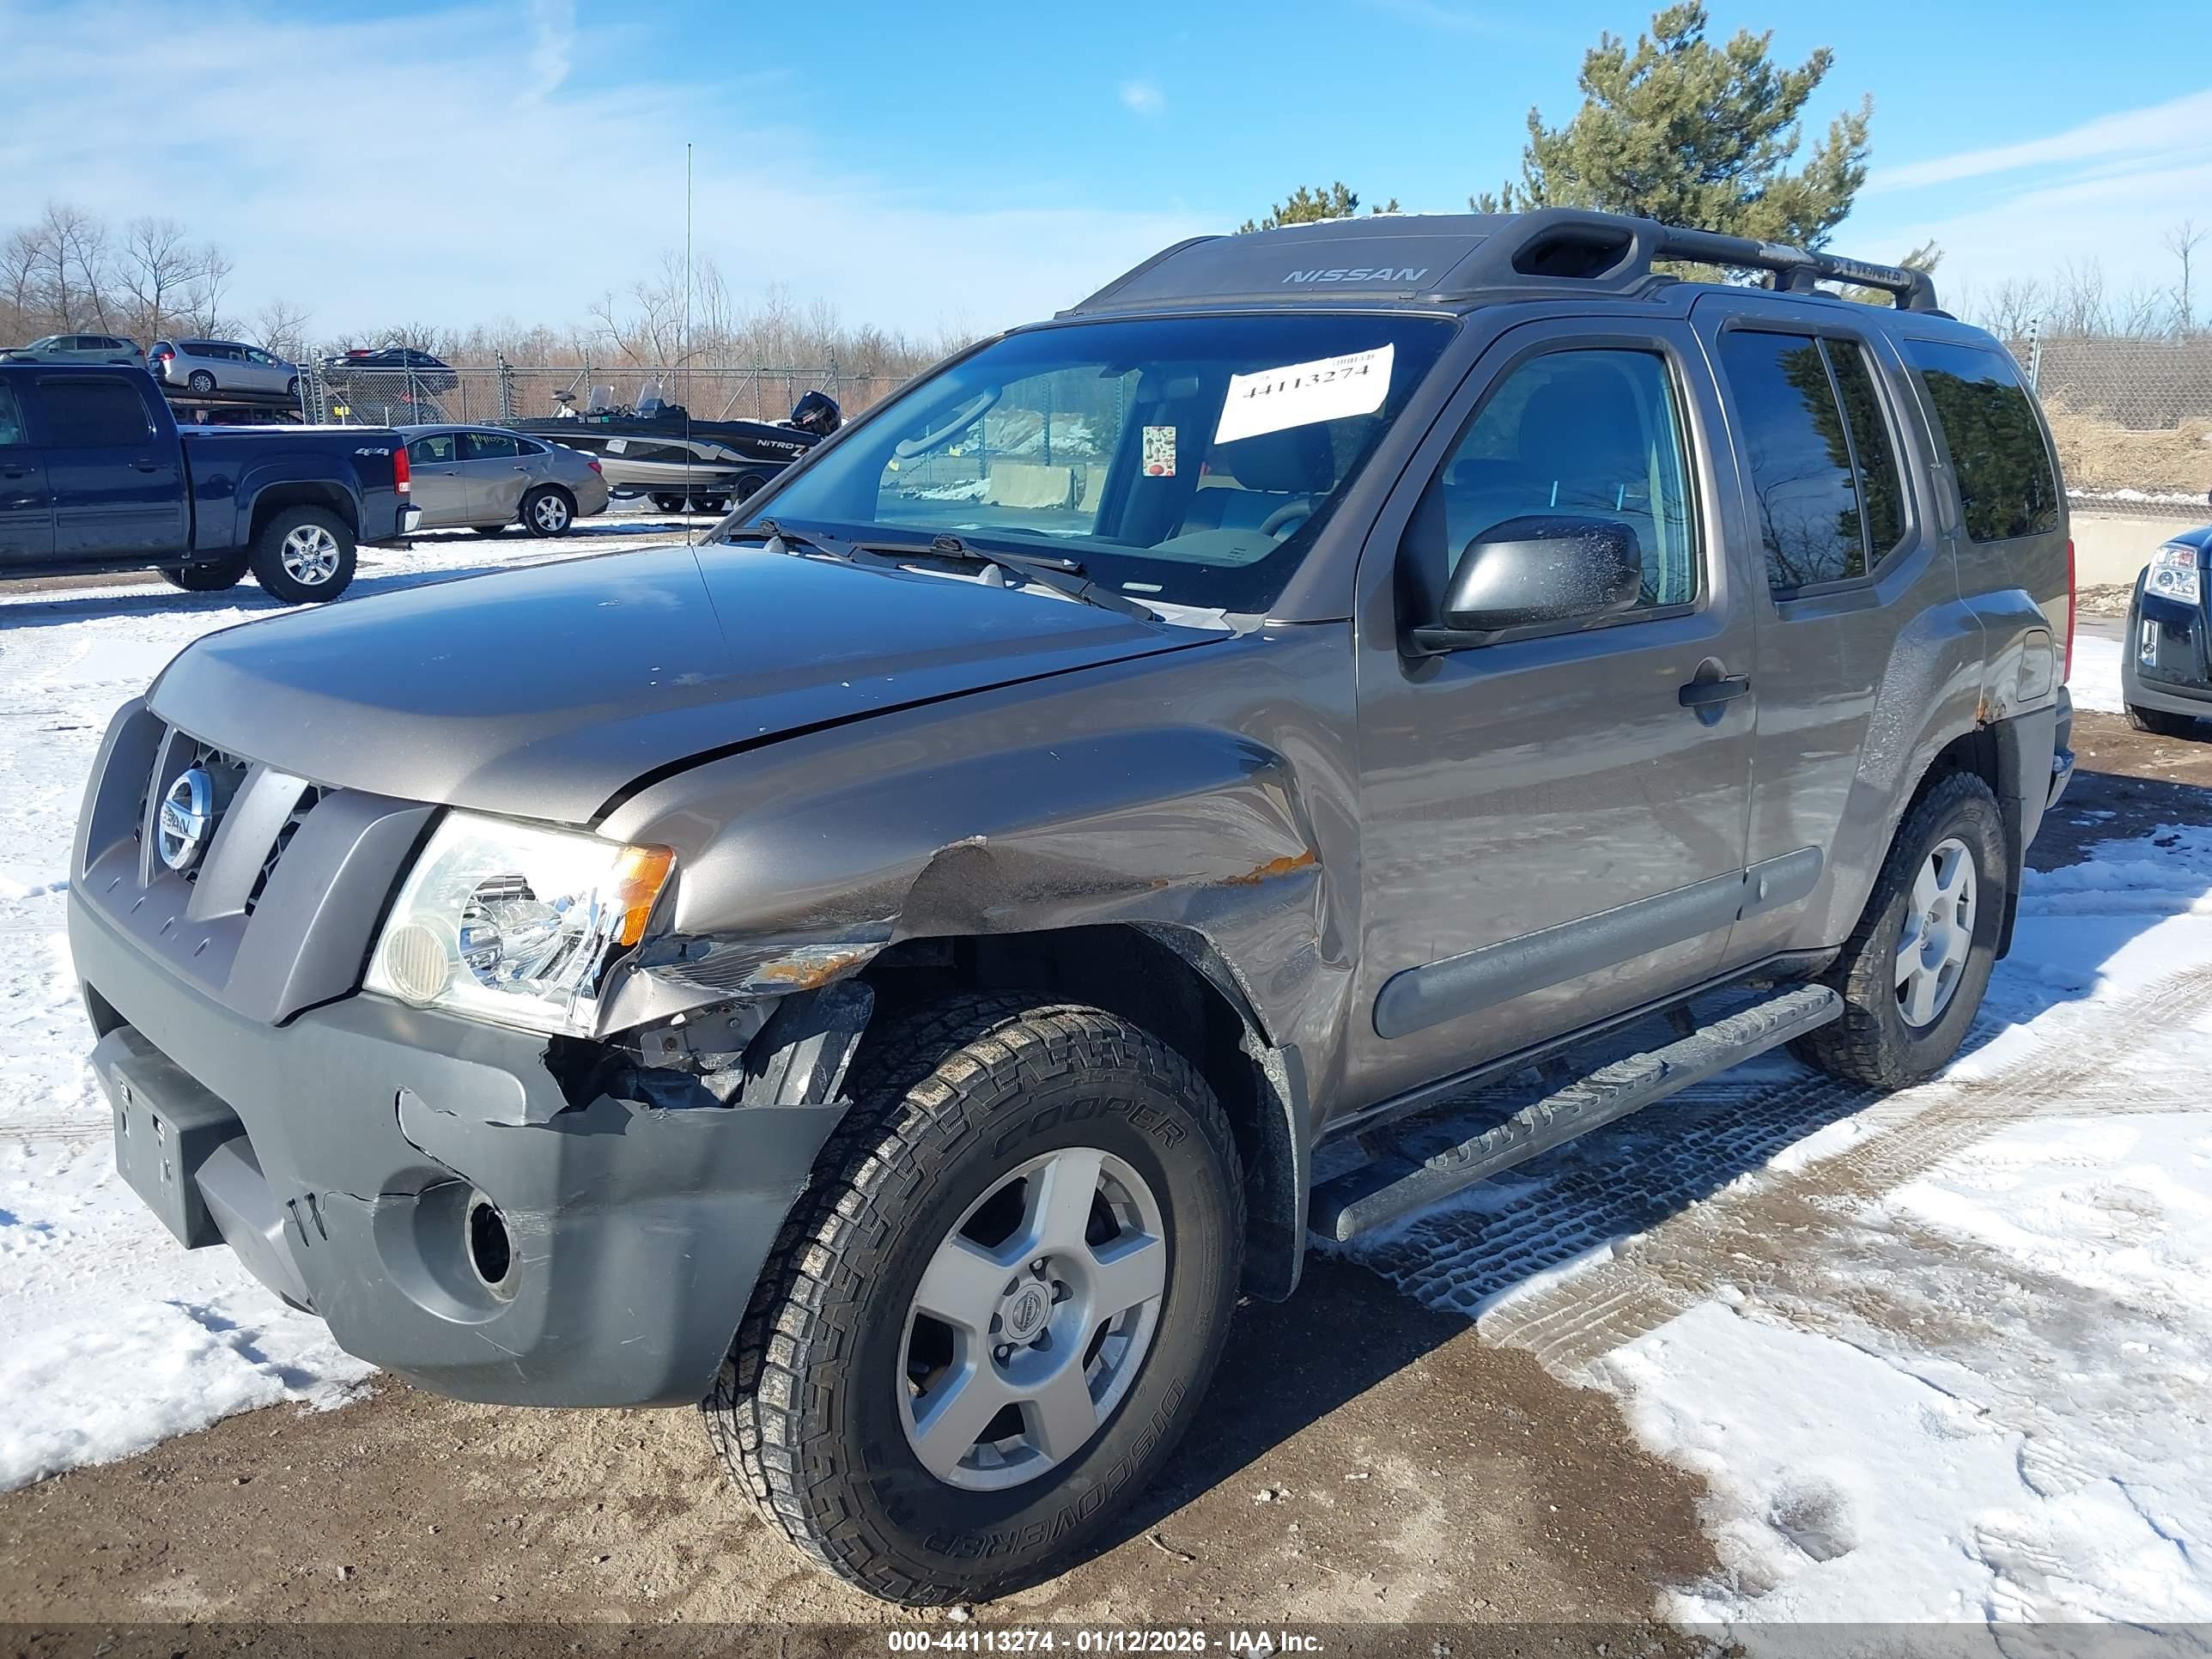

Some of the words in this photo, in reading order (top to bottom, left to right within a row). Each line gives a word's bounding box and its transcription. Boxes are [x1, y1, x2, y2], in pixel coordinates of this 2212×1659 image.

[1281, 268, 1429, 283] NISSAN
[1243, 364, 1370, 399] 44113274
[757, 439, 794, 450] NITRO
[993, 1097, 1187, 1160] COOPER
[1023, 1293, 1036, 1329] NISSAN
[922, 1377, 1188, 1560] DISCOVERER
